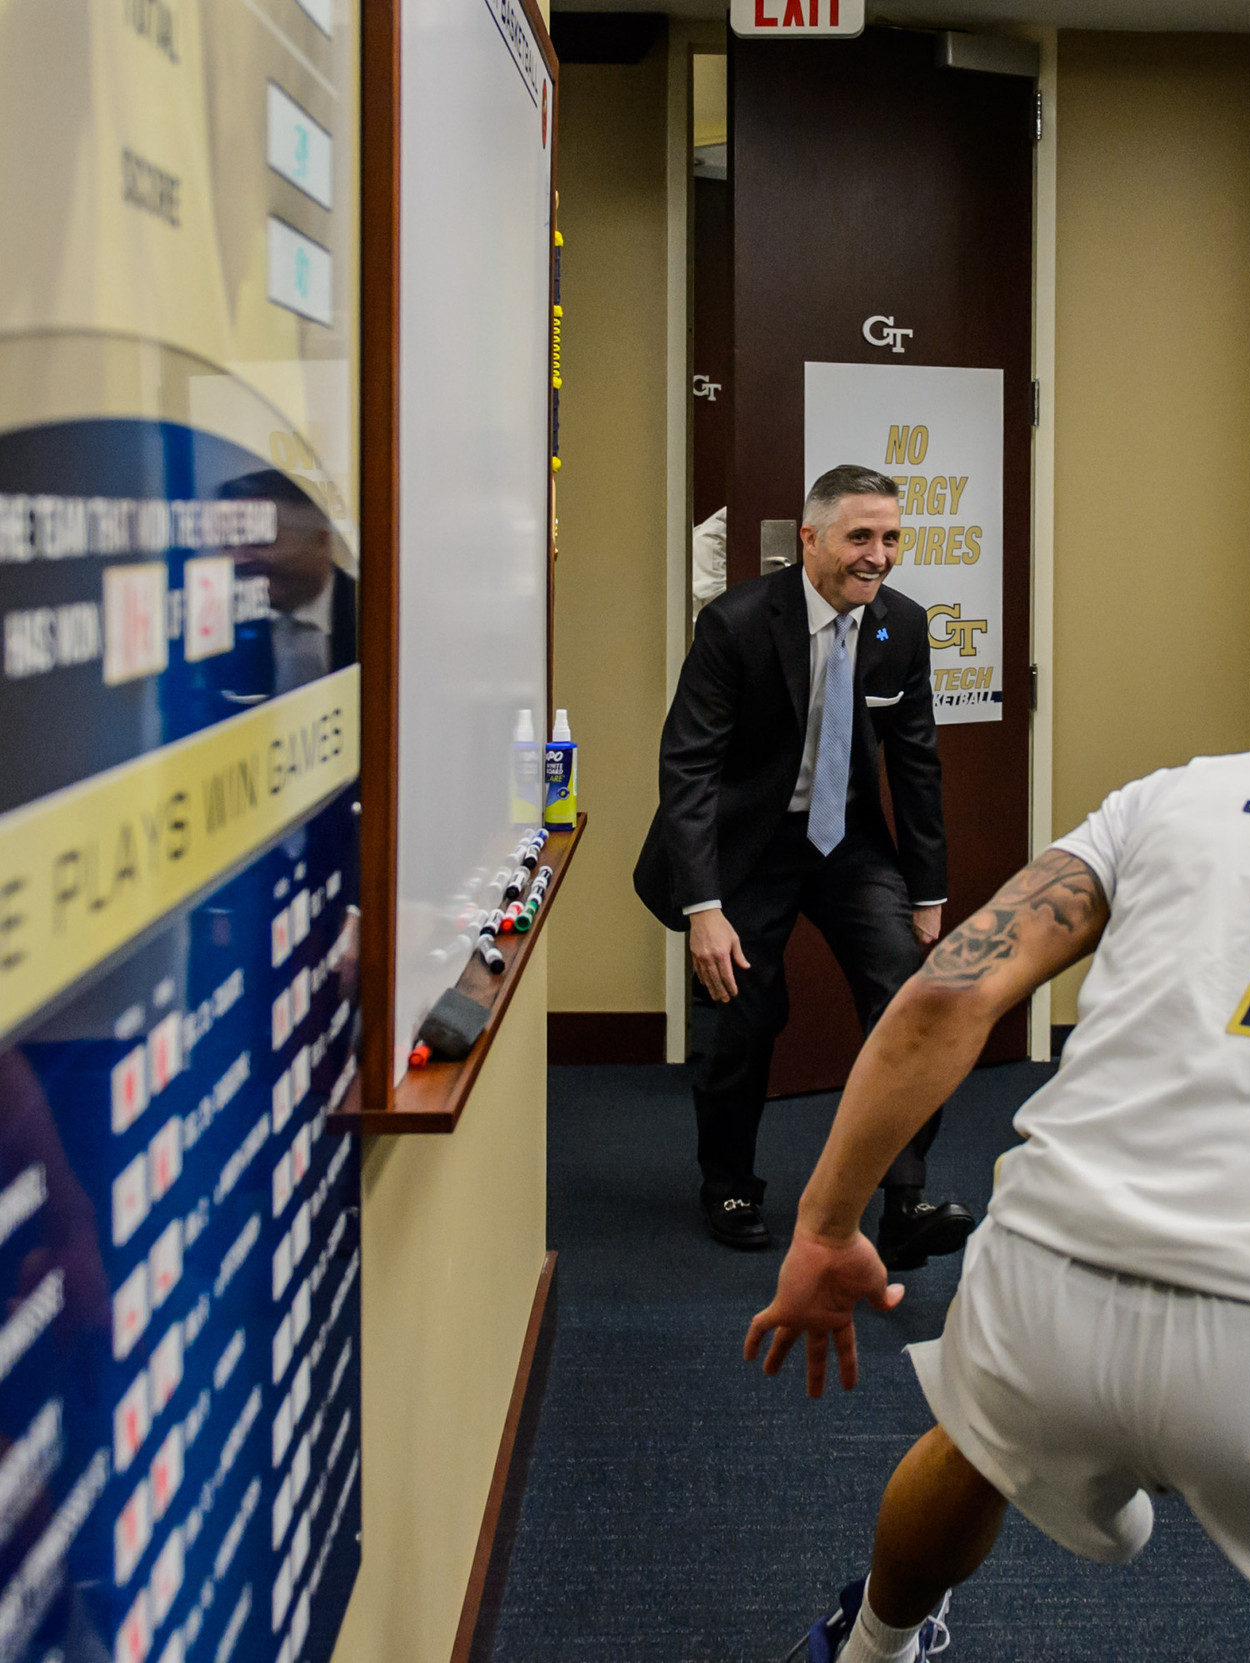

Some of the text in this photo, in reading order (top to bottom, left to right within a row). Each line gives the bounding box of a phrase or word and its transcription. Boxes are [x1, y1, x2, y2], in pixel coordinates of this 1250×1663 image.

[862, 315, 913, 353] GT
[693, 374, 722, 401] GT
[885, 425, 929, 465] NO
[888, 476, 969, 515] ERGY
[927, 603, 987, 657] GT
[934, 666, 994, 691] TECH
